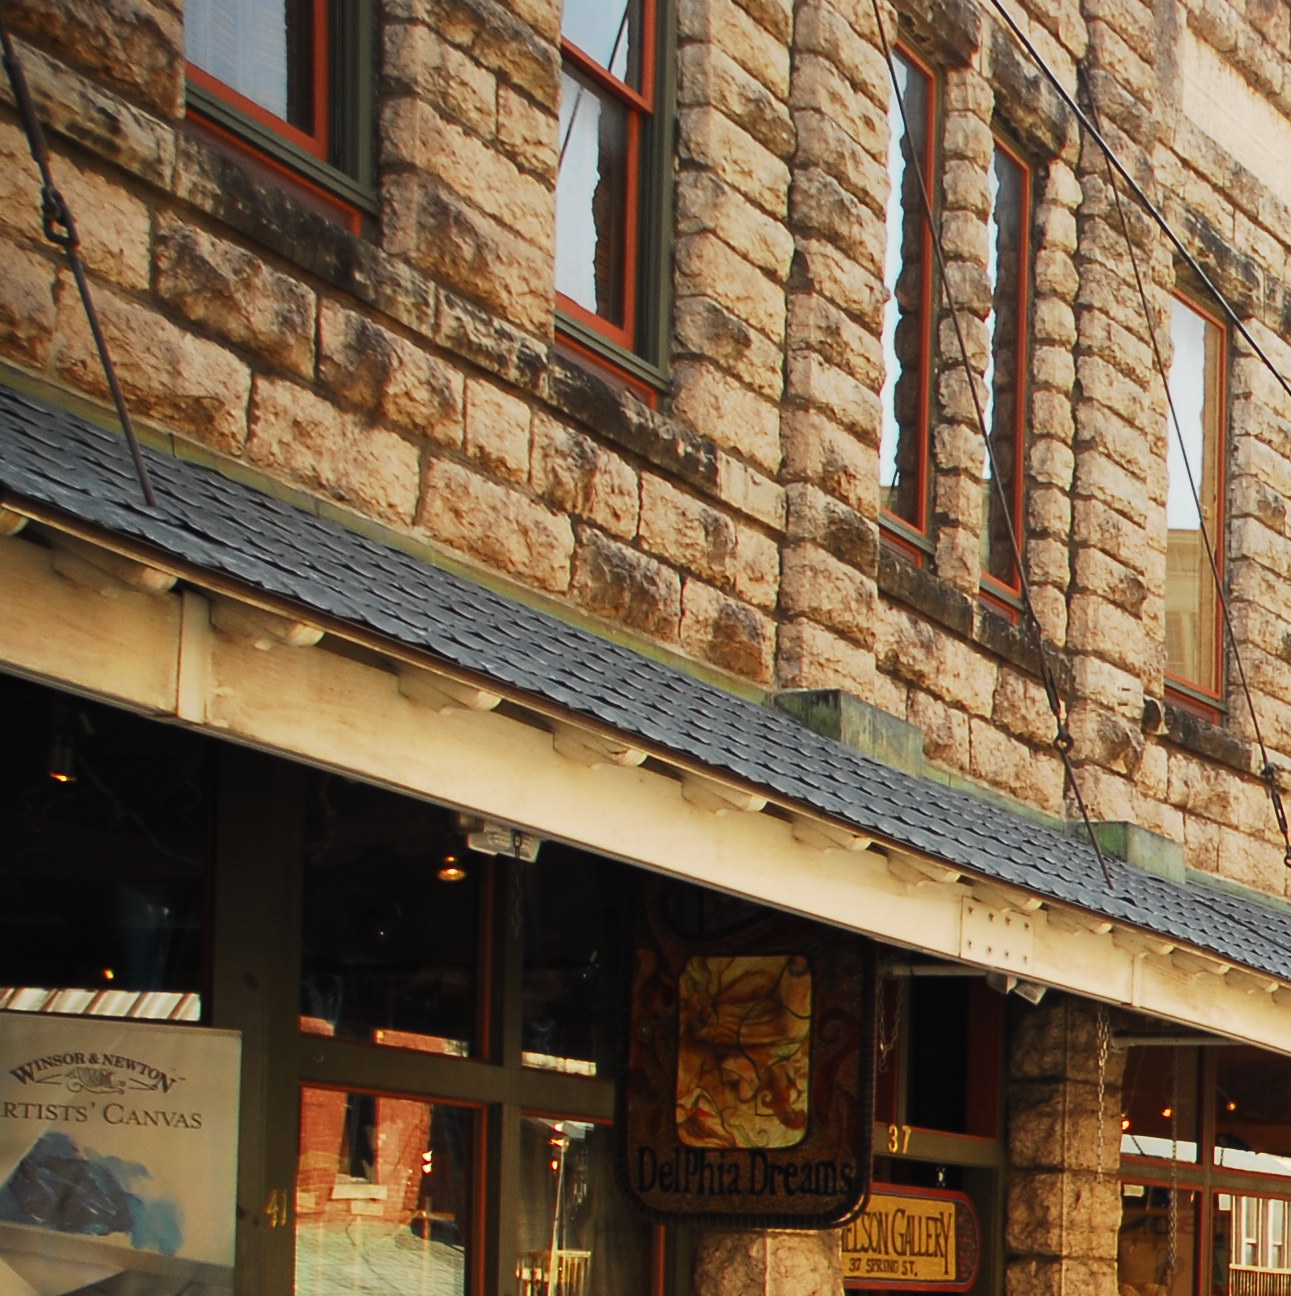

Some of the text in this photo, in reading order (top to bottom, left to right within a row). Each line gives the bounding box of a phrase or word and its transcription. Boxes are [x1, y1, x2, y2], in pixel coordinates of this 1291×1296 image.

[10, 1053, 176, 1094] WINSOR & NEWTON
[0, 1102, 202, 1129] RTISTS' CANVAS
[888, 1124, 912, 1154] 37
[750, 1150, 857, 1196] Dreams
[891, 1208, 952, 1276] GALLERY
[849, 1257, 862, 1274] 37
[866, 1258, 899, 1275] SPRING
